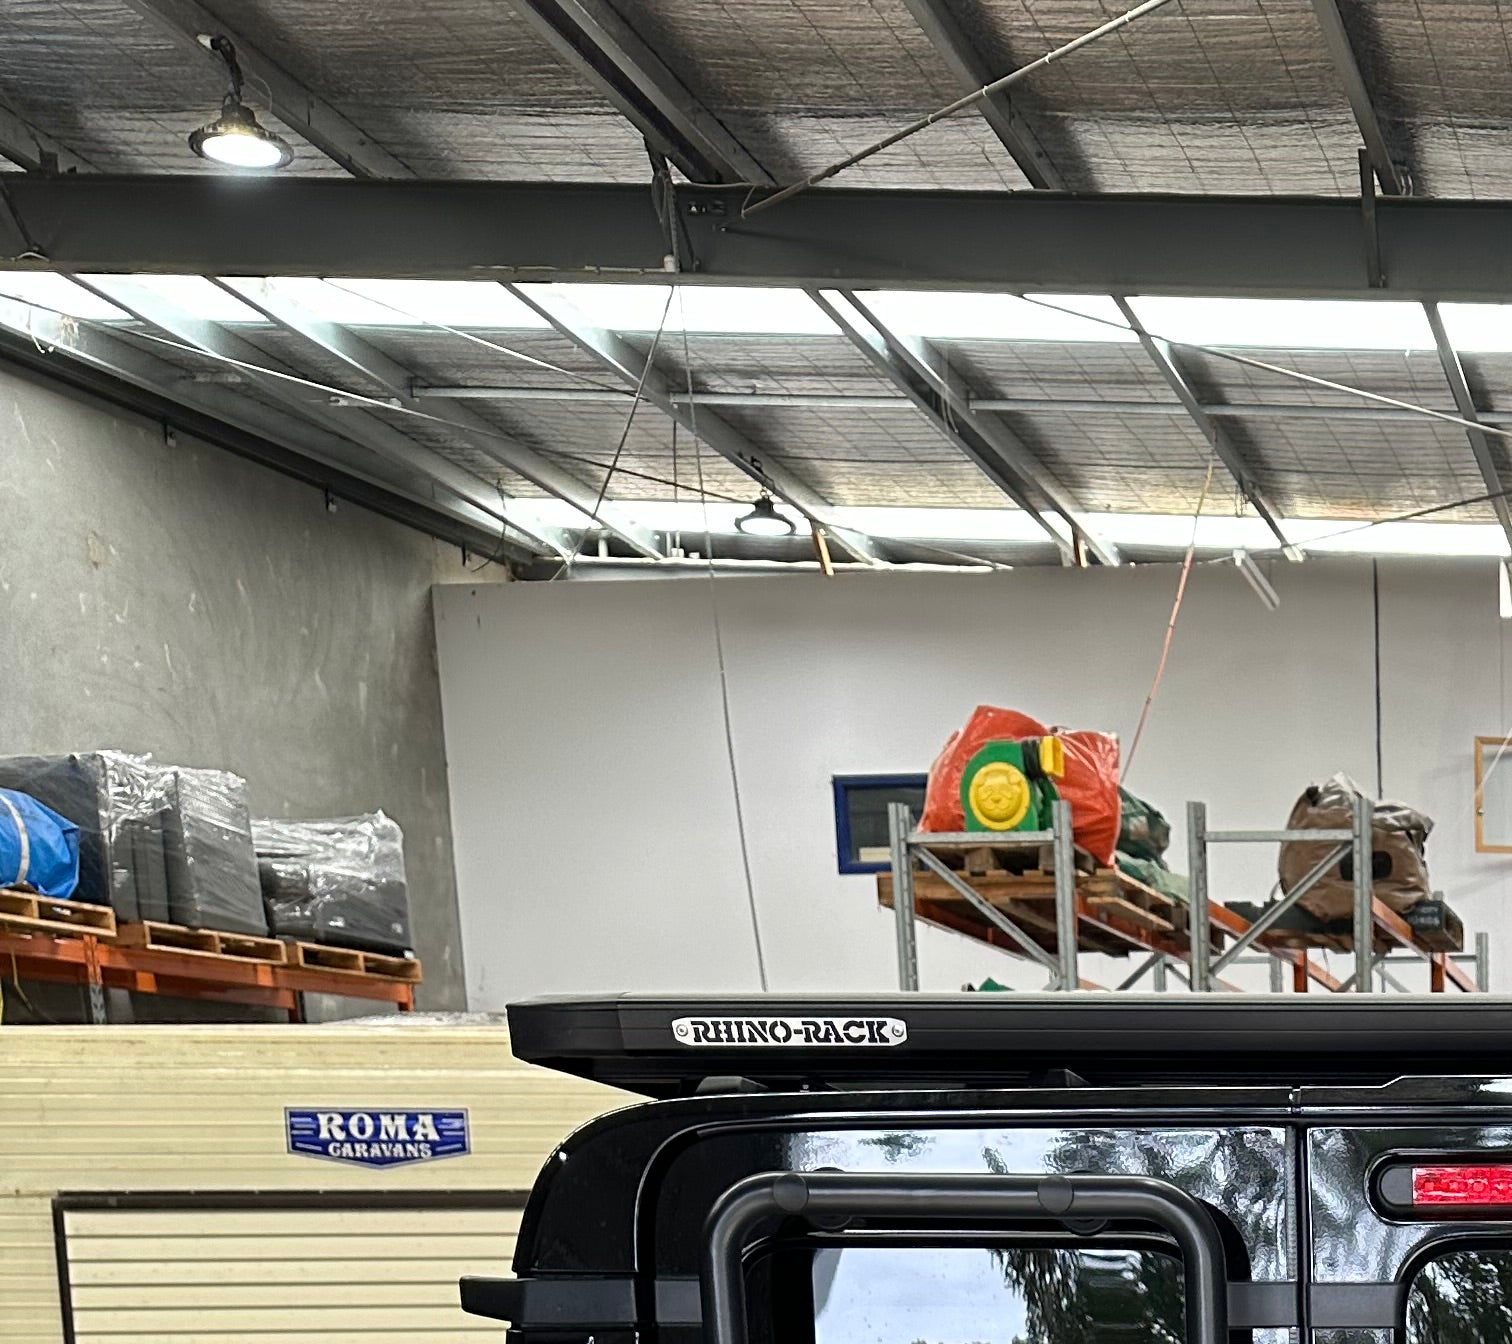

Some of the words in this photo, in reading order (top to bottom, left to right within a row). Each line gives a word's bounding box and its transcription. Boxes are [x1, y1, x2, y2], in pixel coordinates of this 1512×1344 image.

[691, 1020, 890, 1044] RHINO-RACK
[316, 1112, 441, 1141] ROMA
[328, 1142, 432, 1159] CARAVANS
